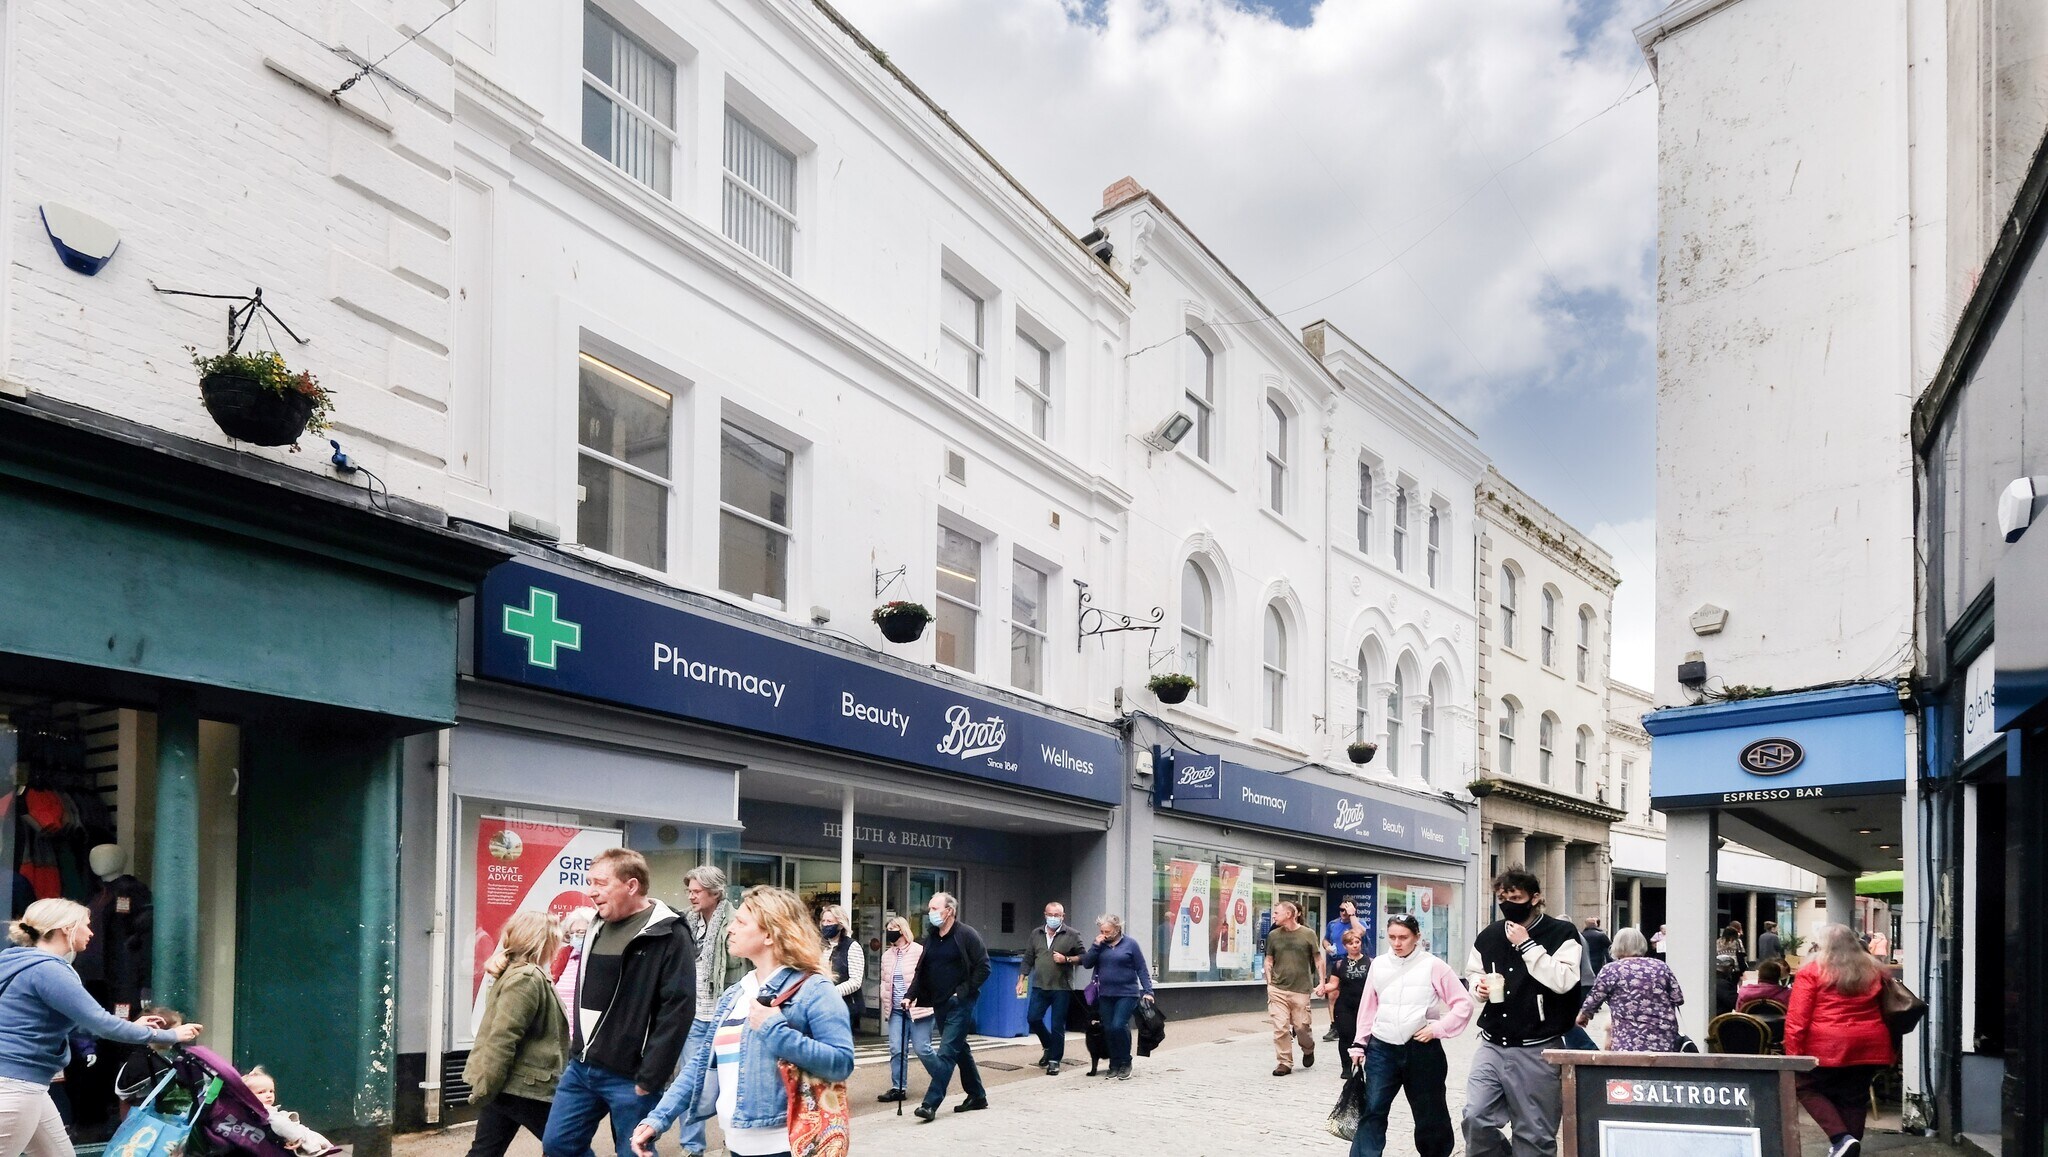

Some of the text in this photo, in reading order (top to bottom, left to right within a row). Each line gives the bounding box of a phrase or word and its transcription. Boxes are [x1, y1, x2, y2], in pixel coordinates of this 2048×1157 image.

[653, 641, 786, 708] Pharmacy
[841, 691, 910, 737] Beauty
[936, 705, 1007, 760] Boots
[986, 757, 1018, 773] Since 1849
[1040, 743, 1094, 775] Wellness
[1177, 765, 1216, 786] Boots
[1242, 786, 1287, 814] Pharmacy
[1723, 787, 1823, 803] ESPRESSO BAR
[1333, 798, 1365, 833] Boots
[823, 822, 953, 850] HELTH & BEAUTY
[1382, 817, 1405, 838] Beauty
[1420, 826, 1444, 843] Wellness
[488, 864, 519, 874] GREAT
[560, 856, 592, 871] GRE
[487, 873, 523, 882] ADVICE
[1330, 881, 1372, 889] welcome
[1193, 886, 1206, 895] PRICE
[1193, 905, 1200, 918] £2
[1632, 1084, 1748, 1106] SALTROCK
